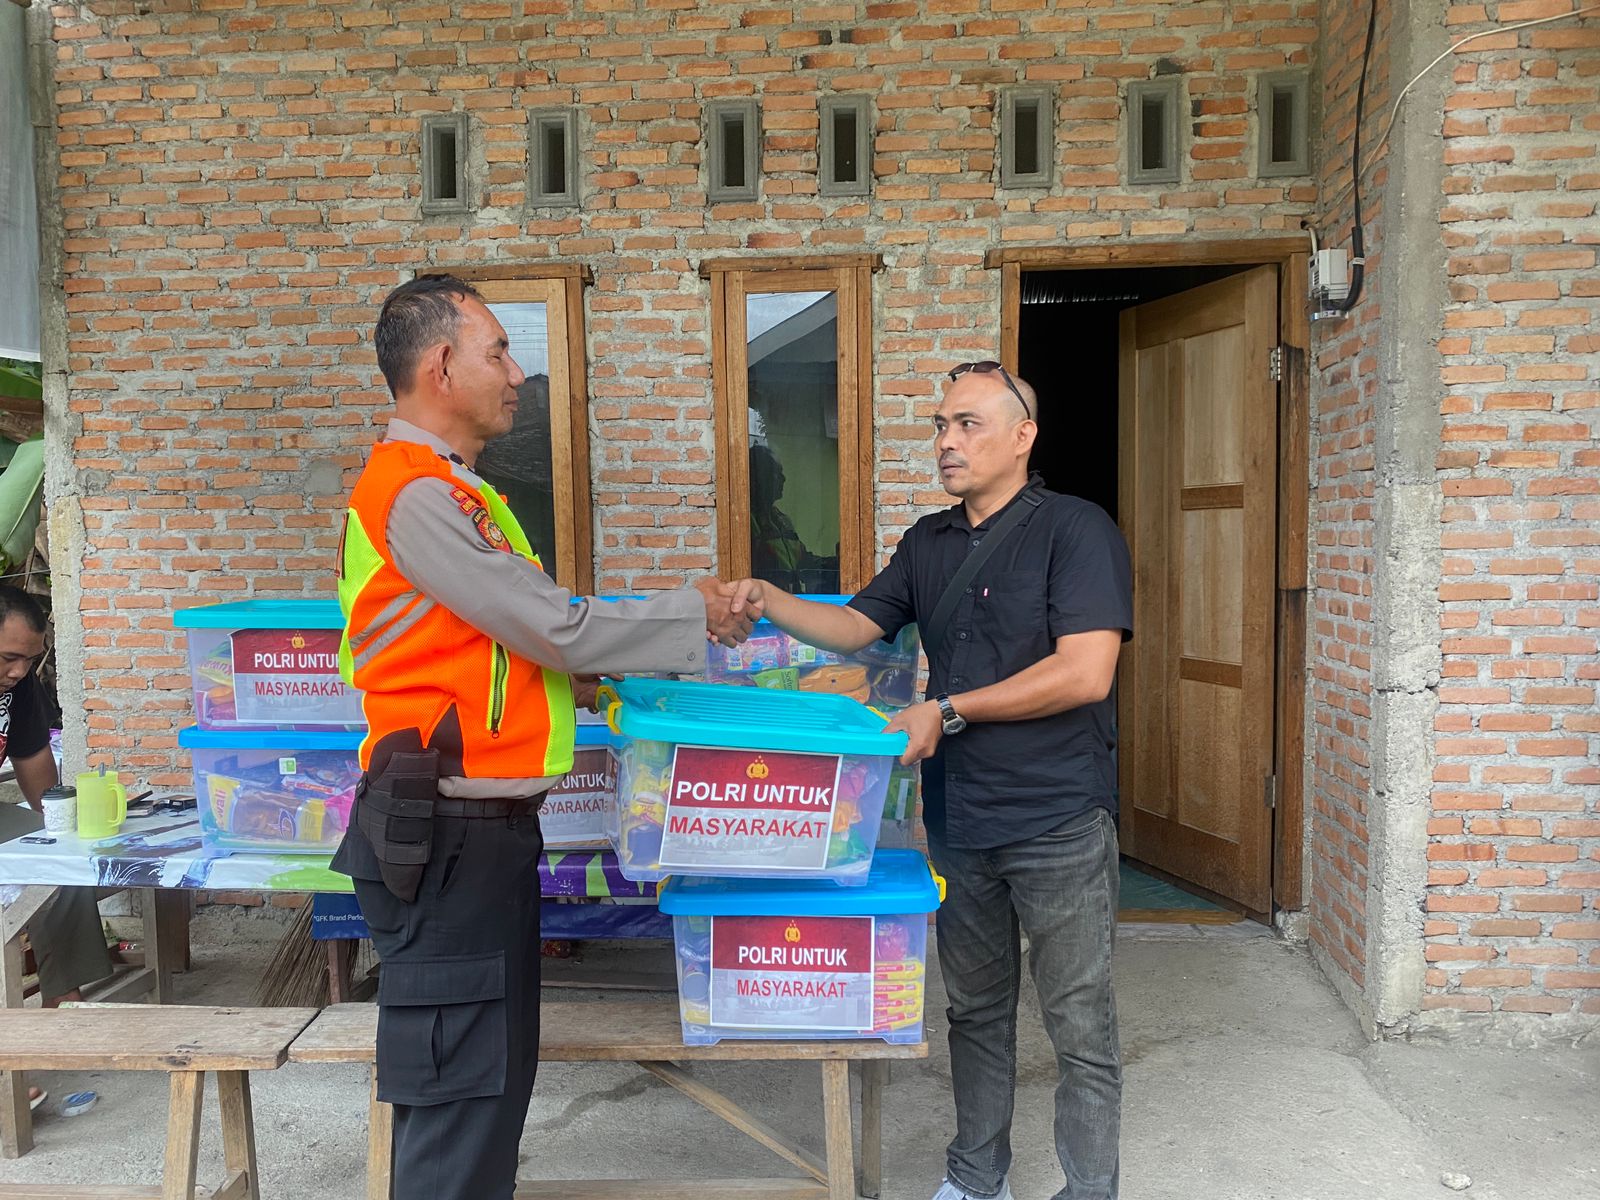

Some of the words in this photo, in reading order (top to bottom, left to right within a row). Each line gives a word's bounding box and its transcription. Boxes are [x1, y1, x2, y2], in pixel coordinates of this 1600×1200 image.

[254, 652, 295, 668] POLRI
[255, 681, 346, 696] MASYARAKAT
[676, 781, 747, 802] POLRI
[753, 784, 832, 806] UNTUK
[540, 798, 605, 816] SYARAKAT
[669, 815, 827, 838] MASYARAKAT
[738, 946, 787, 965] POLRI
[791, 947, 848, 966] UNTUK
[737, 979, 848, 998] MASYARAKAT
